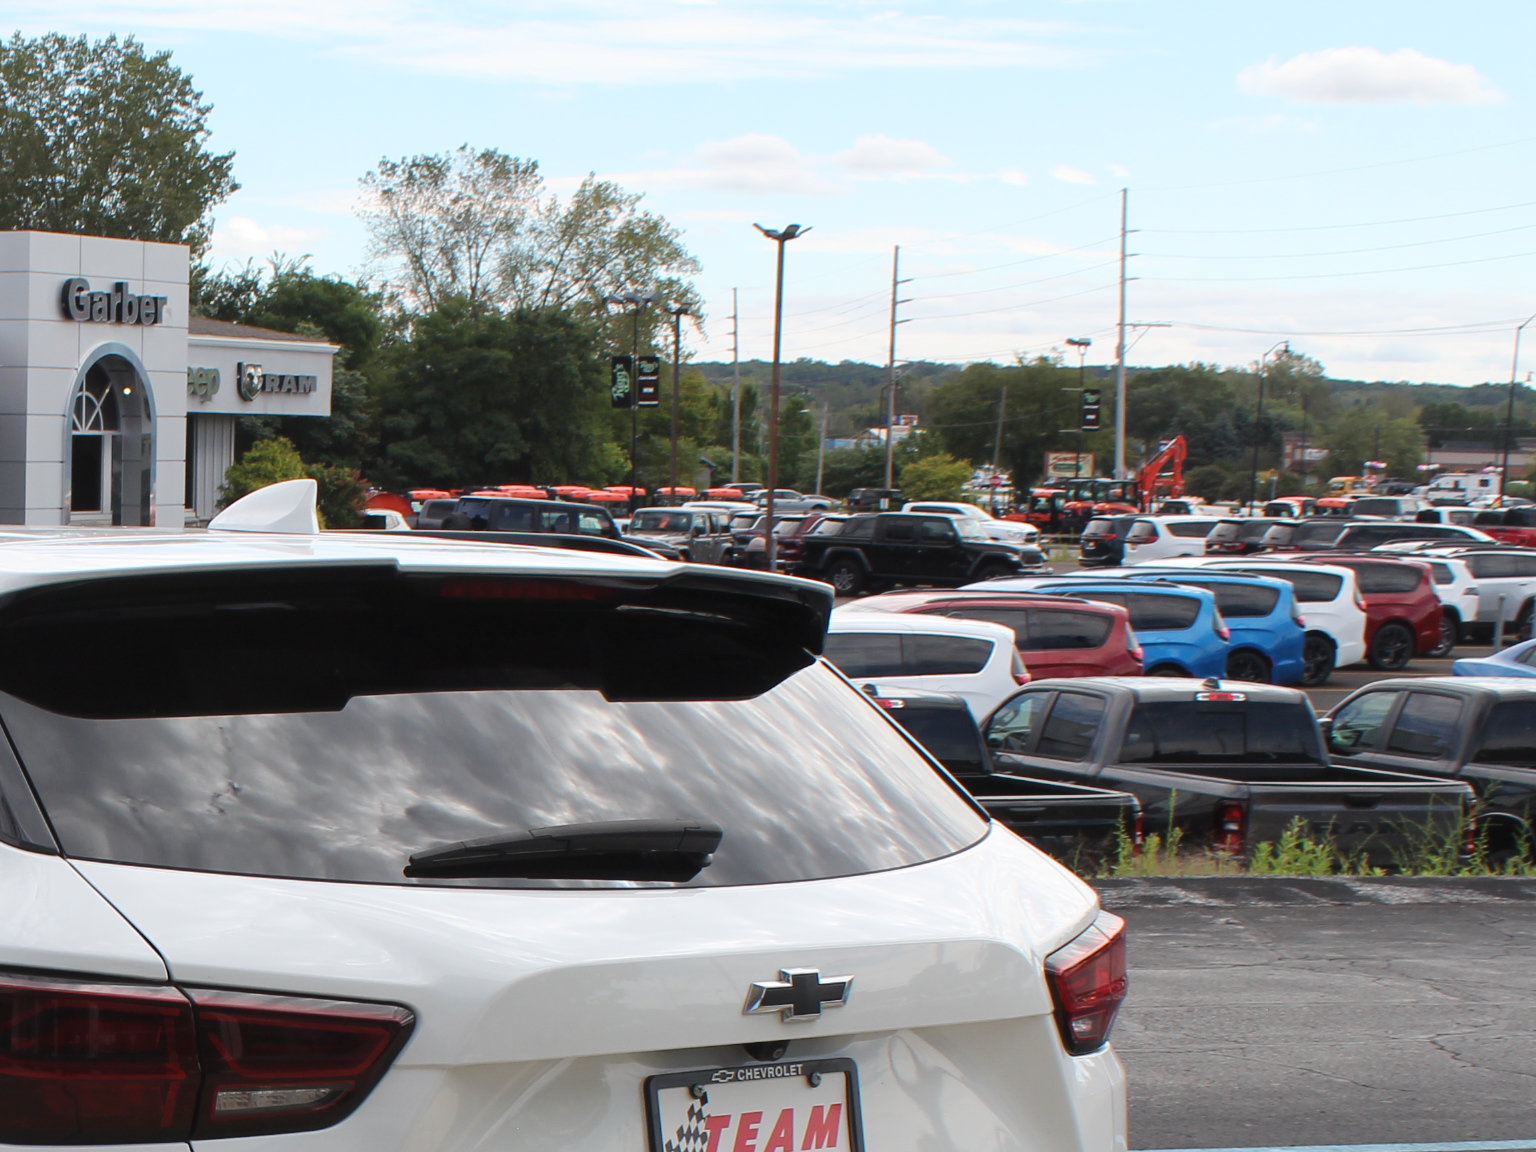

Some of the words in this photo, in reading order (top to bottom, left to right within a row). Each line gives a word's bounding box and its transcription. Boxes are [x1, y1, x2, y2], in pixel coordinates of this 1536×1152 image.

[61, 277, 168, 326] Garber
[264, 373, 317, 394] RAM
[737, 1063, 804, 1082] CHEVROLET
